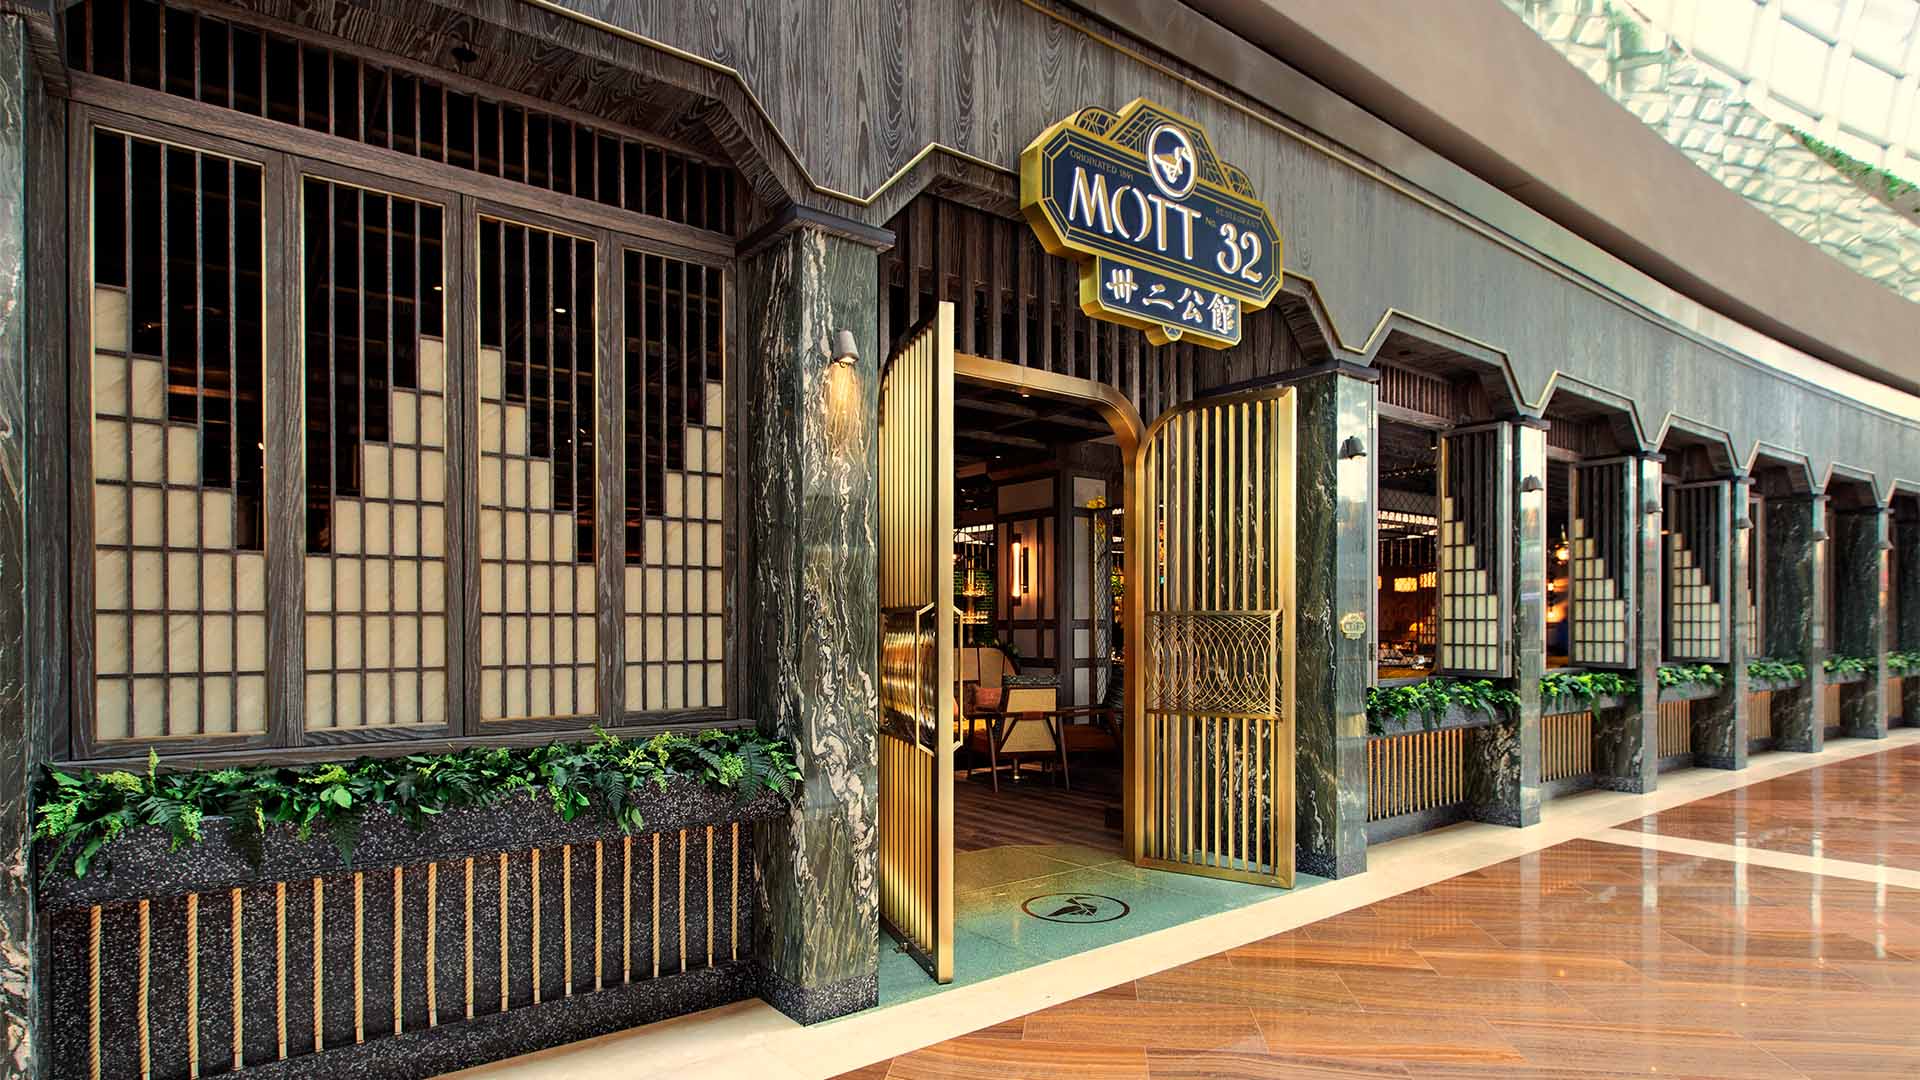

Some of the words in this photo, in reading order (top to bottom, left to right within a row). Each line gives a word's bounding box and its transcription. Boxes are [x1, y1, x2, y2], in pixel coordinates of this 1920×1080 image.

[1069, 166, 1202, 260] MOTT
[1217, 223, 1263, 283] 32
[1105, 268, 1235, 334] 卅二公館
